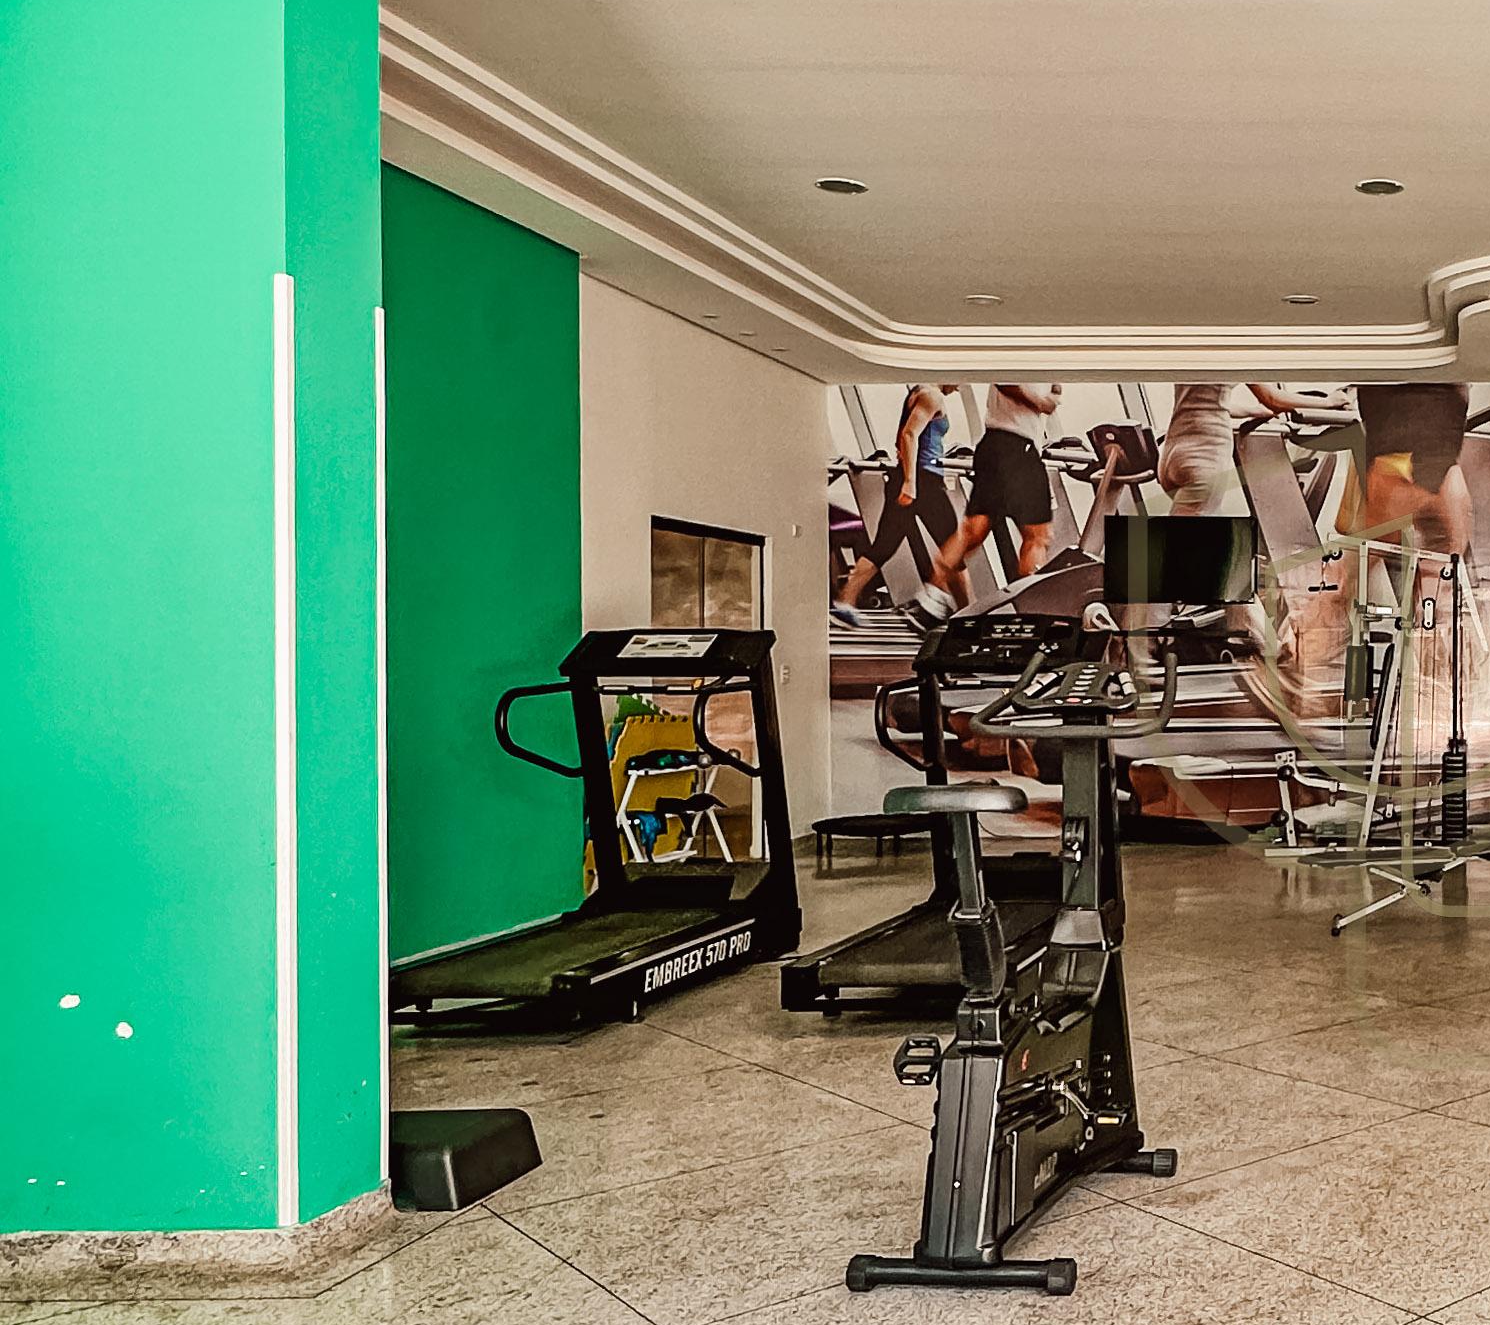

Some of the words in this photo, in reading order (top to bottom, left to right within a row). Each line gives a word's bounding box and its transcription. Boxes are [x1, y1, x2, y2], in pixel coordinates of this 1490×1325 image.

[644, 948, 704, 993] EMBREEX
[705, 939, 727, 967] 570
[728, 930, 752, 958] PRO
